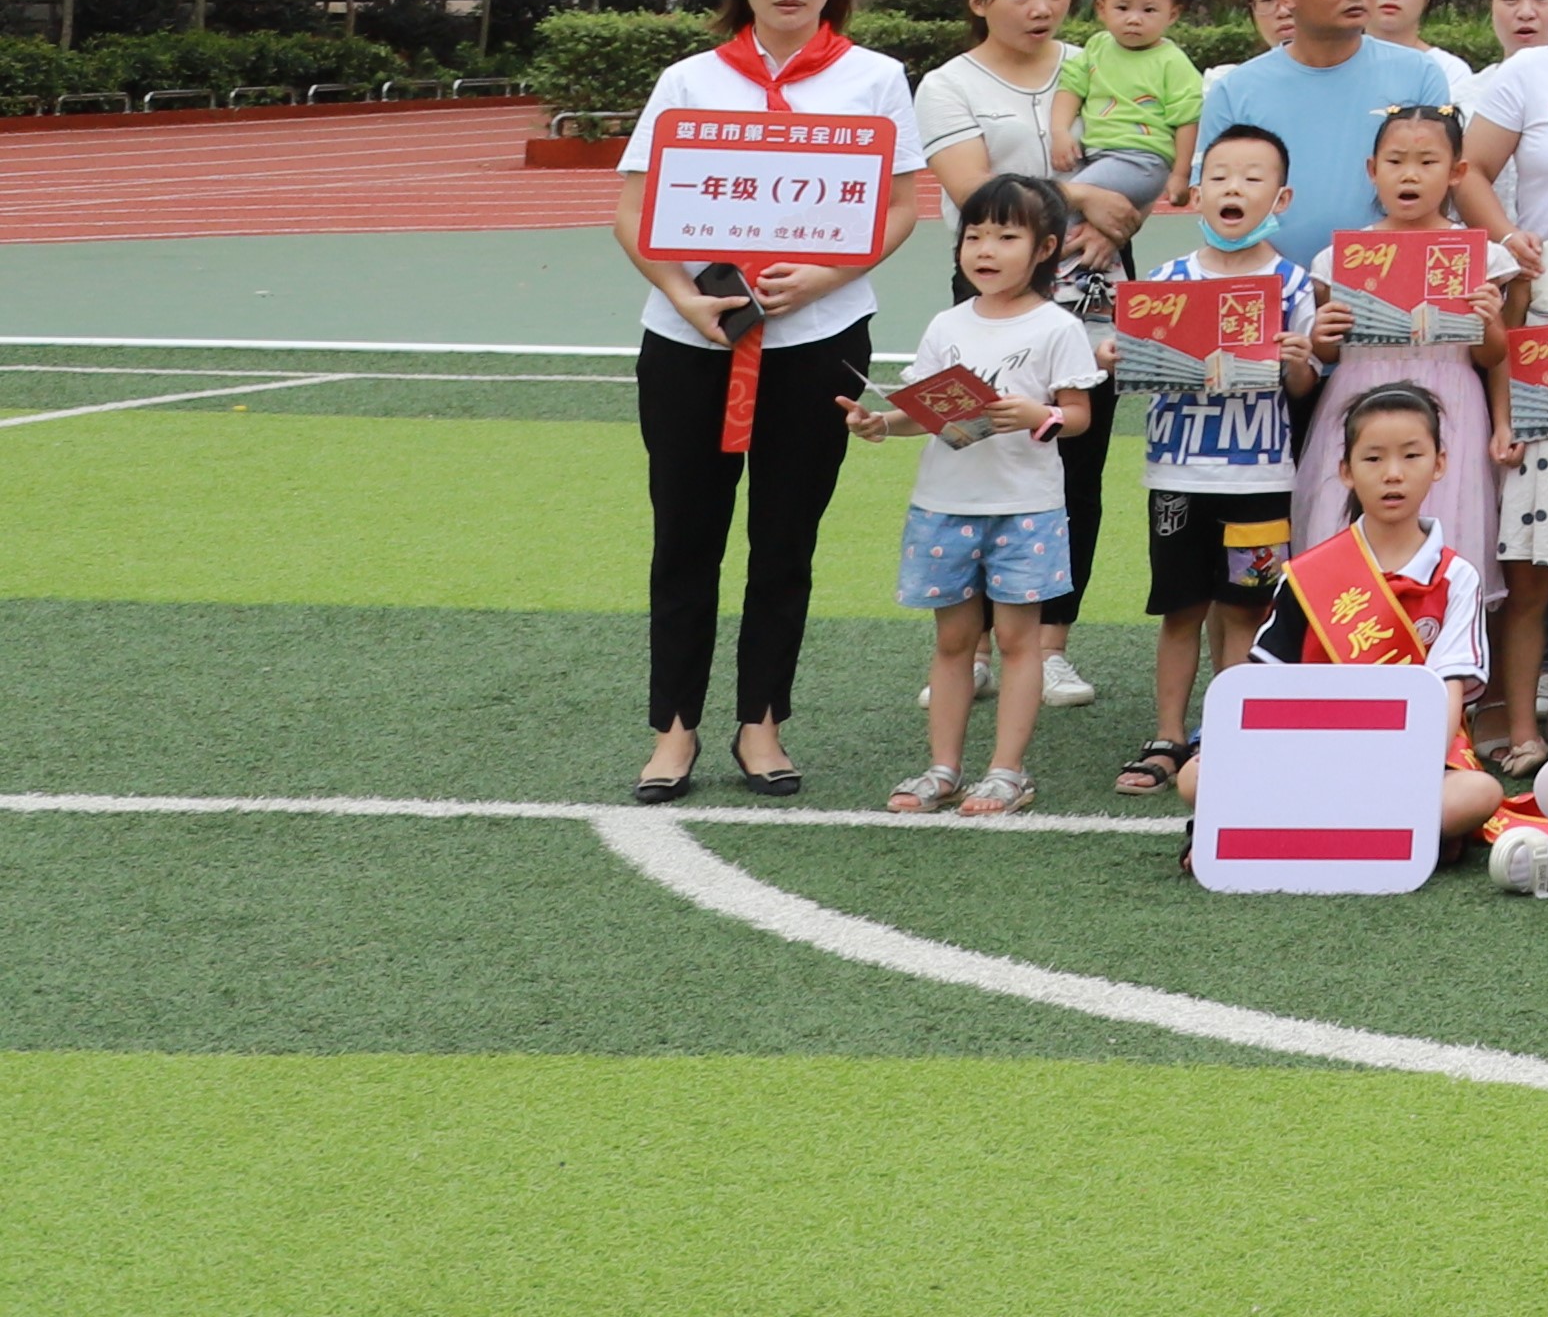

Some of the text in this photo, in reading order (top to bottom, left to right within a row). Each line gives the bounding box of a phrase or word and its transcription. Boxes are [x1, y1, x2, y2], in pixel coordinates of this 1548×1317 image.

[675, 121, 876, 146] 娄底市第二完全小学
[1342, 243, 1398, 277] 2021
[1126, 293, 1188, 327] 2021
[1216, 698, 1413, 861] 二
